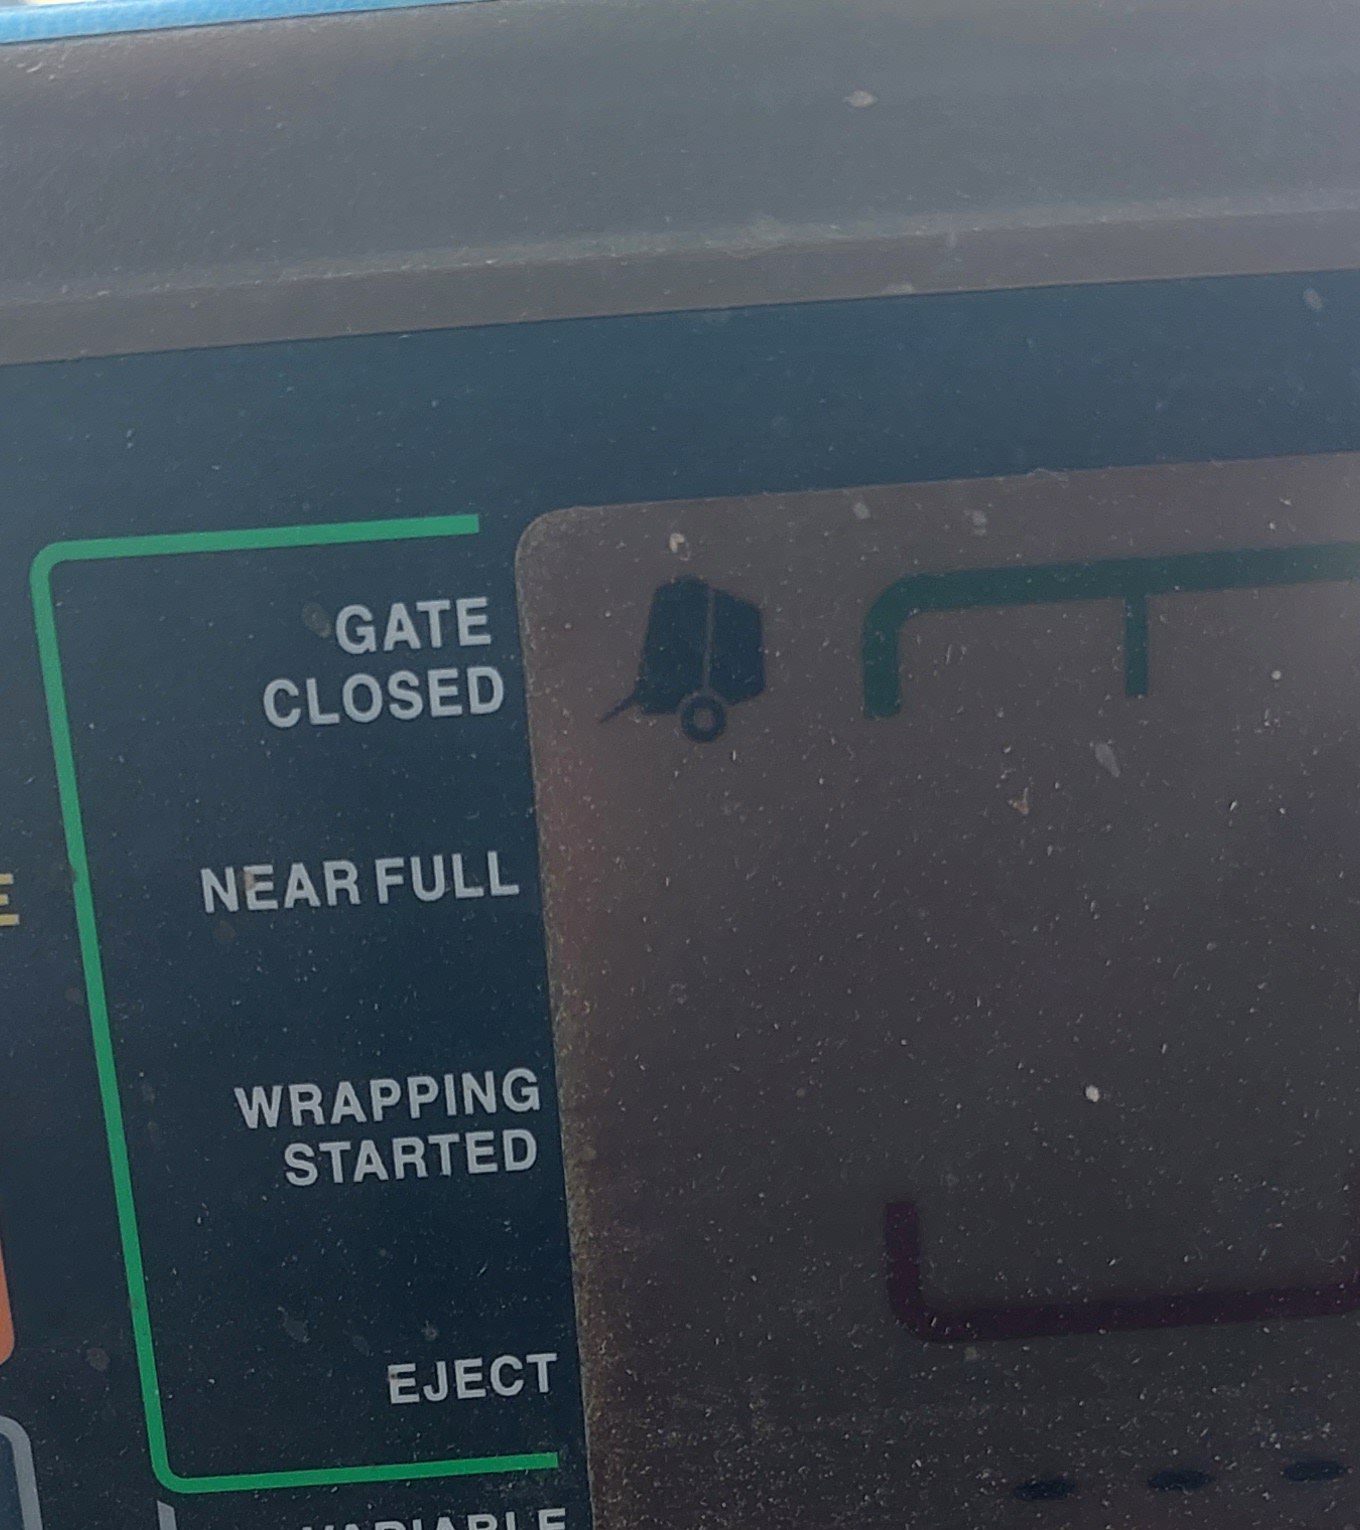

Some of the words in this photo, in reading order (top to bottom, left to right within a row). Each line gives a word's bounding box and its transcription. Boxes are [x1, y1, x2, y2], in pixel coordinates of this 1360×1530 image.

[336, 596, 492, 655] GATE
[263, 665, 505, 728] CLOSED
[200, 859, 360, 913] NEAR
[375, 850, 520, 904] FULL
[234, 1067, 541, 1129] WRAPPING
[284, 1128, 537, 1187] STARTED
[387, 1352, 557, 1404] EJECT
